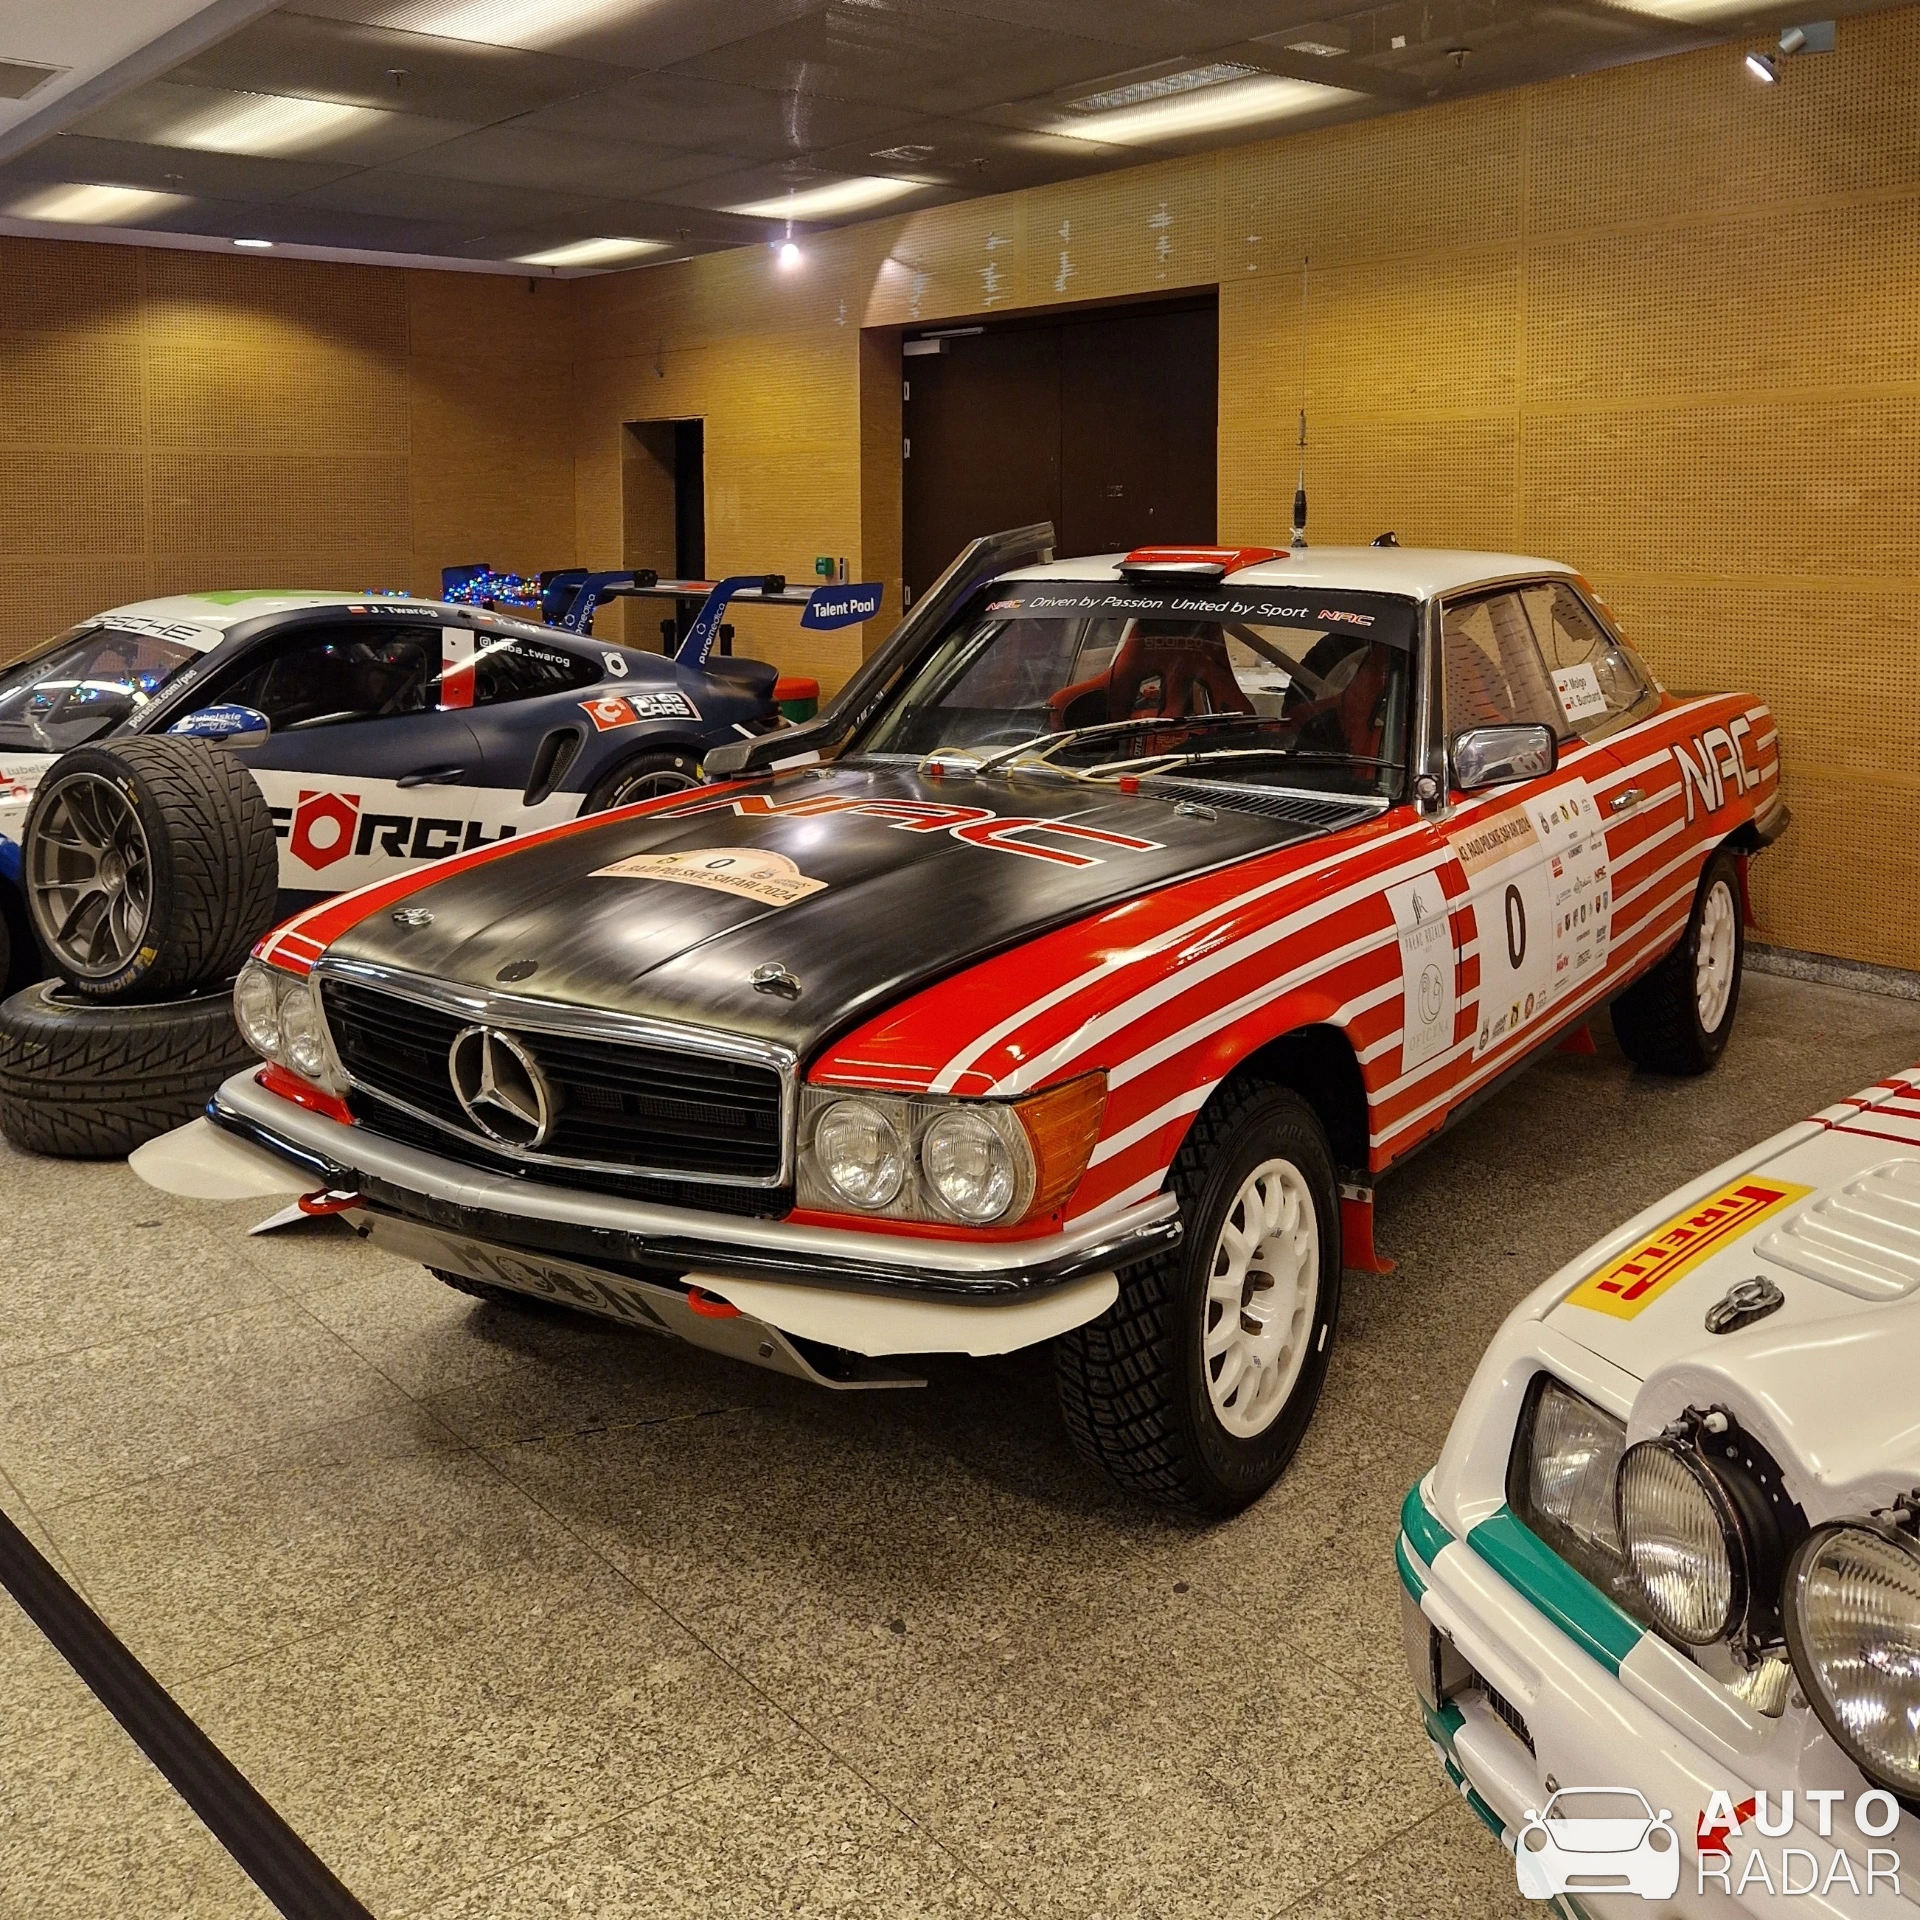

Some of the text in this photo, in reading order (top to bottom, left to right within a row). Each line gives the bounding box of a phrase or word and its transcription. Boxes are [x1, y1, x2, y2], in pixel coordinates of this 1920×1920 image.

[575, 593, 596, 634] omedica
[812, 597, 874, 618] Talent Pool
[1029, 596, 1076, 608] Driven
[1078, 596, 1101, 609] by
[1101, 596, 1164, 609] Passion
[1171, 598, 1230, 612] United
[1230, 601, 1255, 615] by
[1257, 603, 1310, 618] Sport
[1317, 609, 1376, 627] NAC
[698, 602, 726, 664] puromedica
[493, 638, 571, 668] uba_twarog
[128, 668, 198, 729] porsche.com/psc
[6, 763, 50, 776] lubels
[705, 858, 736, 869] 0
[656, 866, 711, 881] POLSKIE
[708, 873, 760, 891] SAFARI
[755, 884, 799, 900] 2024
[1504, 883, 1527, 970] 0
[1596, 1184, 1787, 1300] PIRELLI
